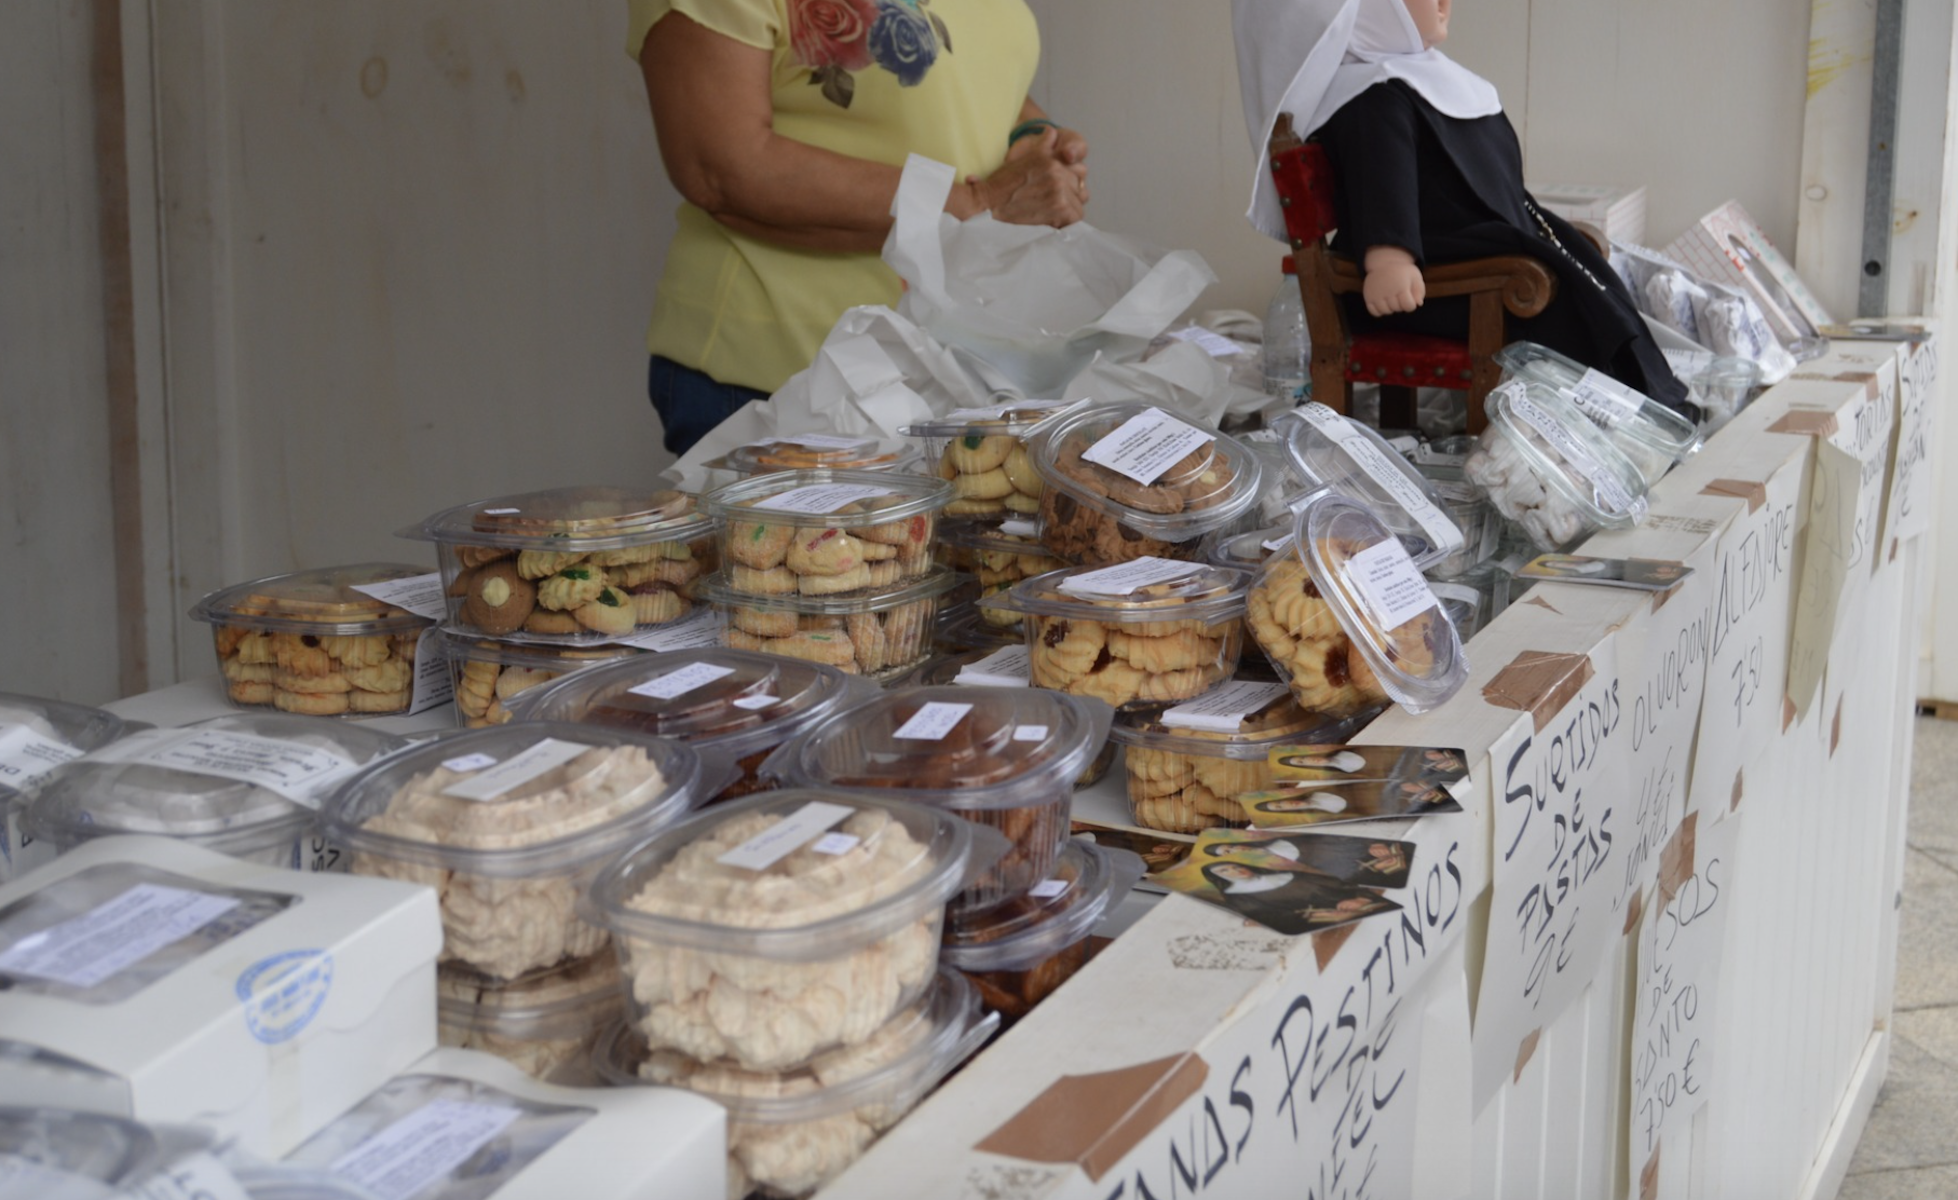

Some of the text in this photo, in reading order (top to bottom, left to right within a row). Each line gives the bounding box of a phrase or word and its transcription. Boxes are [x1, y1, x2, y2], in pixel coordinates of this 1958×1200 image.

[1504, 678, 1620, 863] SURTIDOS
[1547, 787, 1582, 873] DE
[1516, 806, 1612, 955] PASTAS
[1647, 963, 1674, 1027] DE
[1332, 996, 1403, 1140] DE
